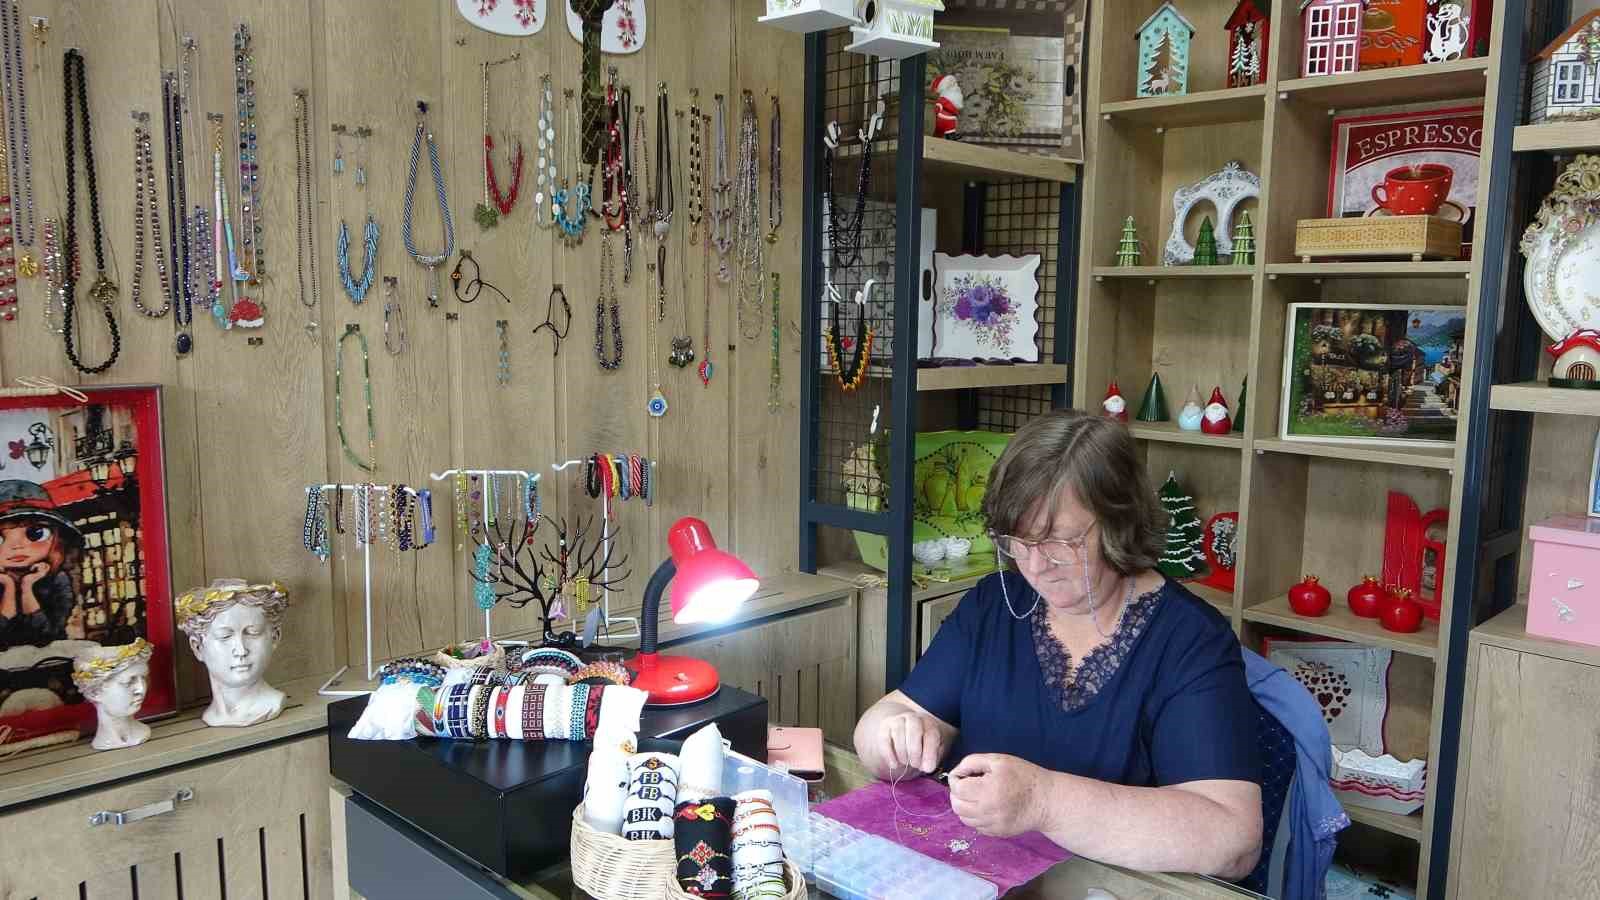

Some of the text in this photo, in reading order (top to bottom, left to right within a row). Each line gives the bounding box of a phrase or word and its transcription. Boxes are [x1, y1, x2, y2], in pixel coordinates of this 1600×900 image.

[1356, 123, 1484, 159] ESPRESSO
[643, 772, 660, 784] FB
[641, 787, 660, 799] FB
[632, 808, 657, 822] BJK
